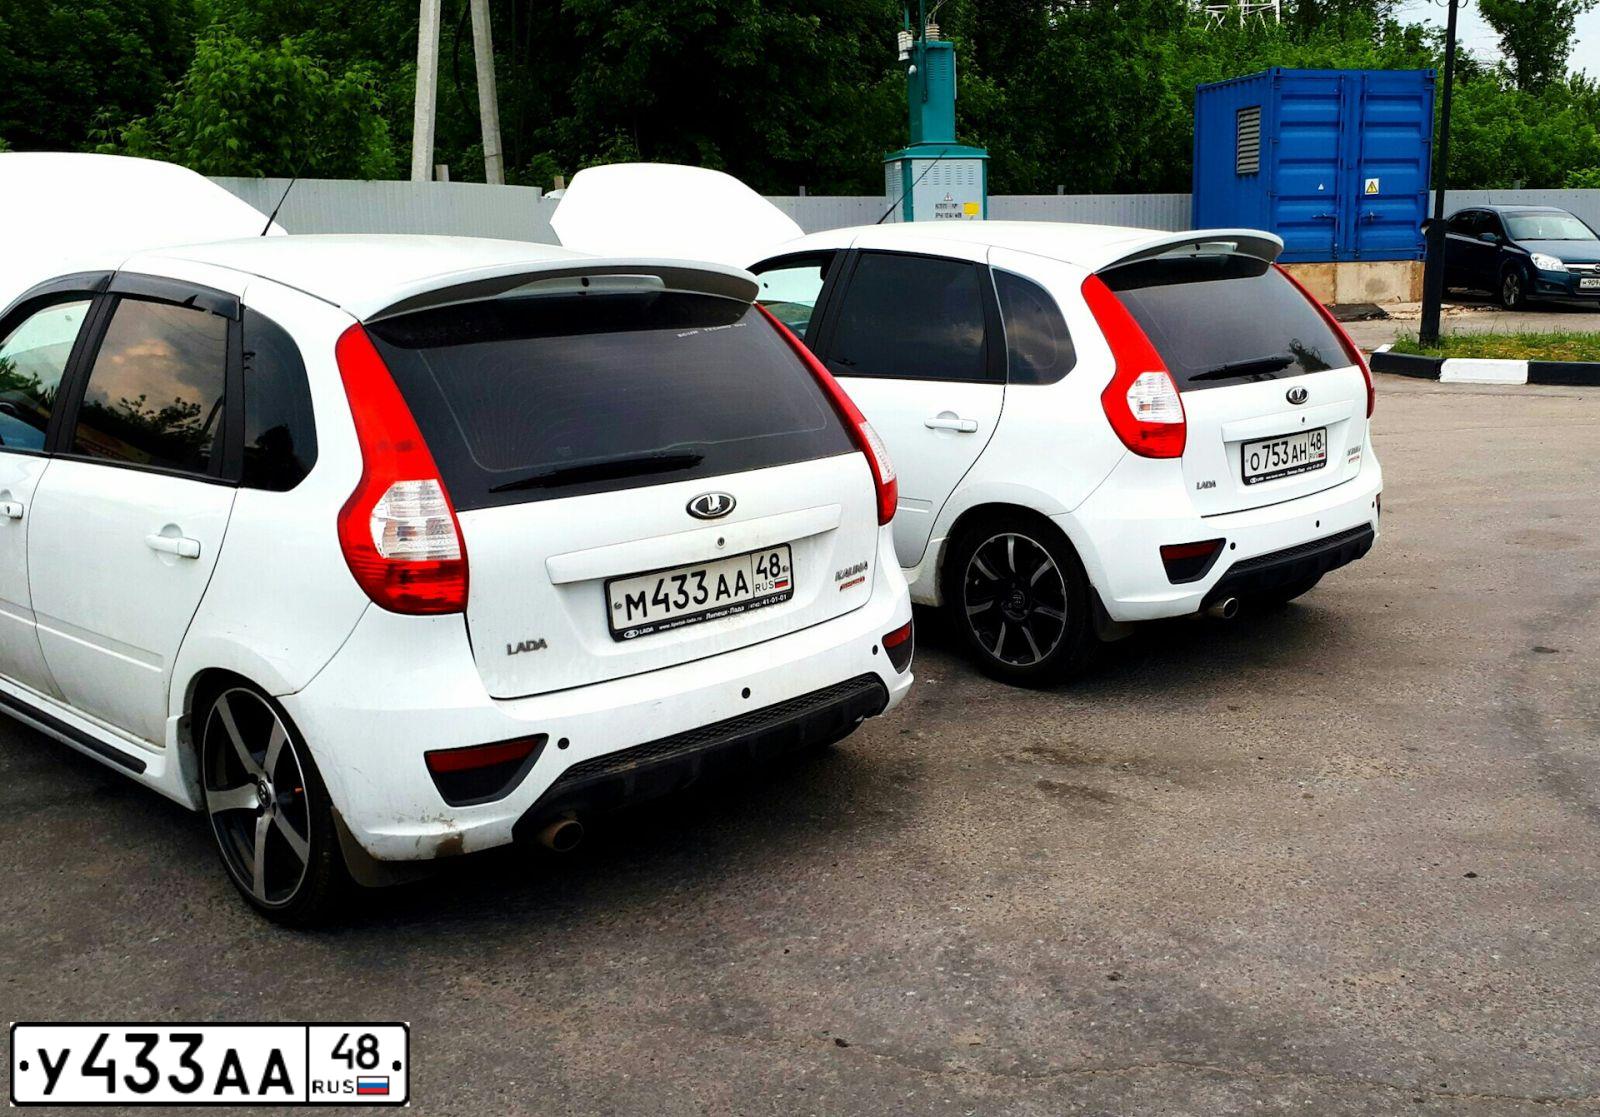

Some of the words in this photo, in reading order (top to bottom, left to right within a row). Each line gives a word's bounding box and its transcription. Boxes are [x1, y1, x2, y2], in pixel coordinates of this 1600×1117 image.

[1310, 432, 1323, 451] 48
[1196, 479, 1217, 490] LADA
[756, 552, 781, 580] 48
[755, 582, 775, 593] RUS
[639, 626, 654, 635] LADA
[506, 637, 548, 656] LADA
